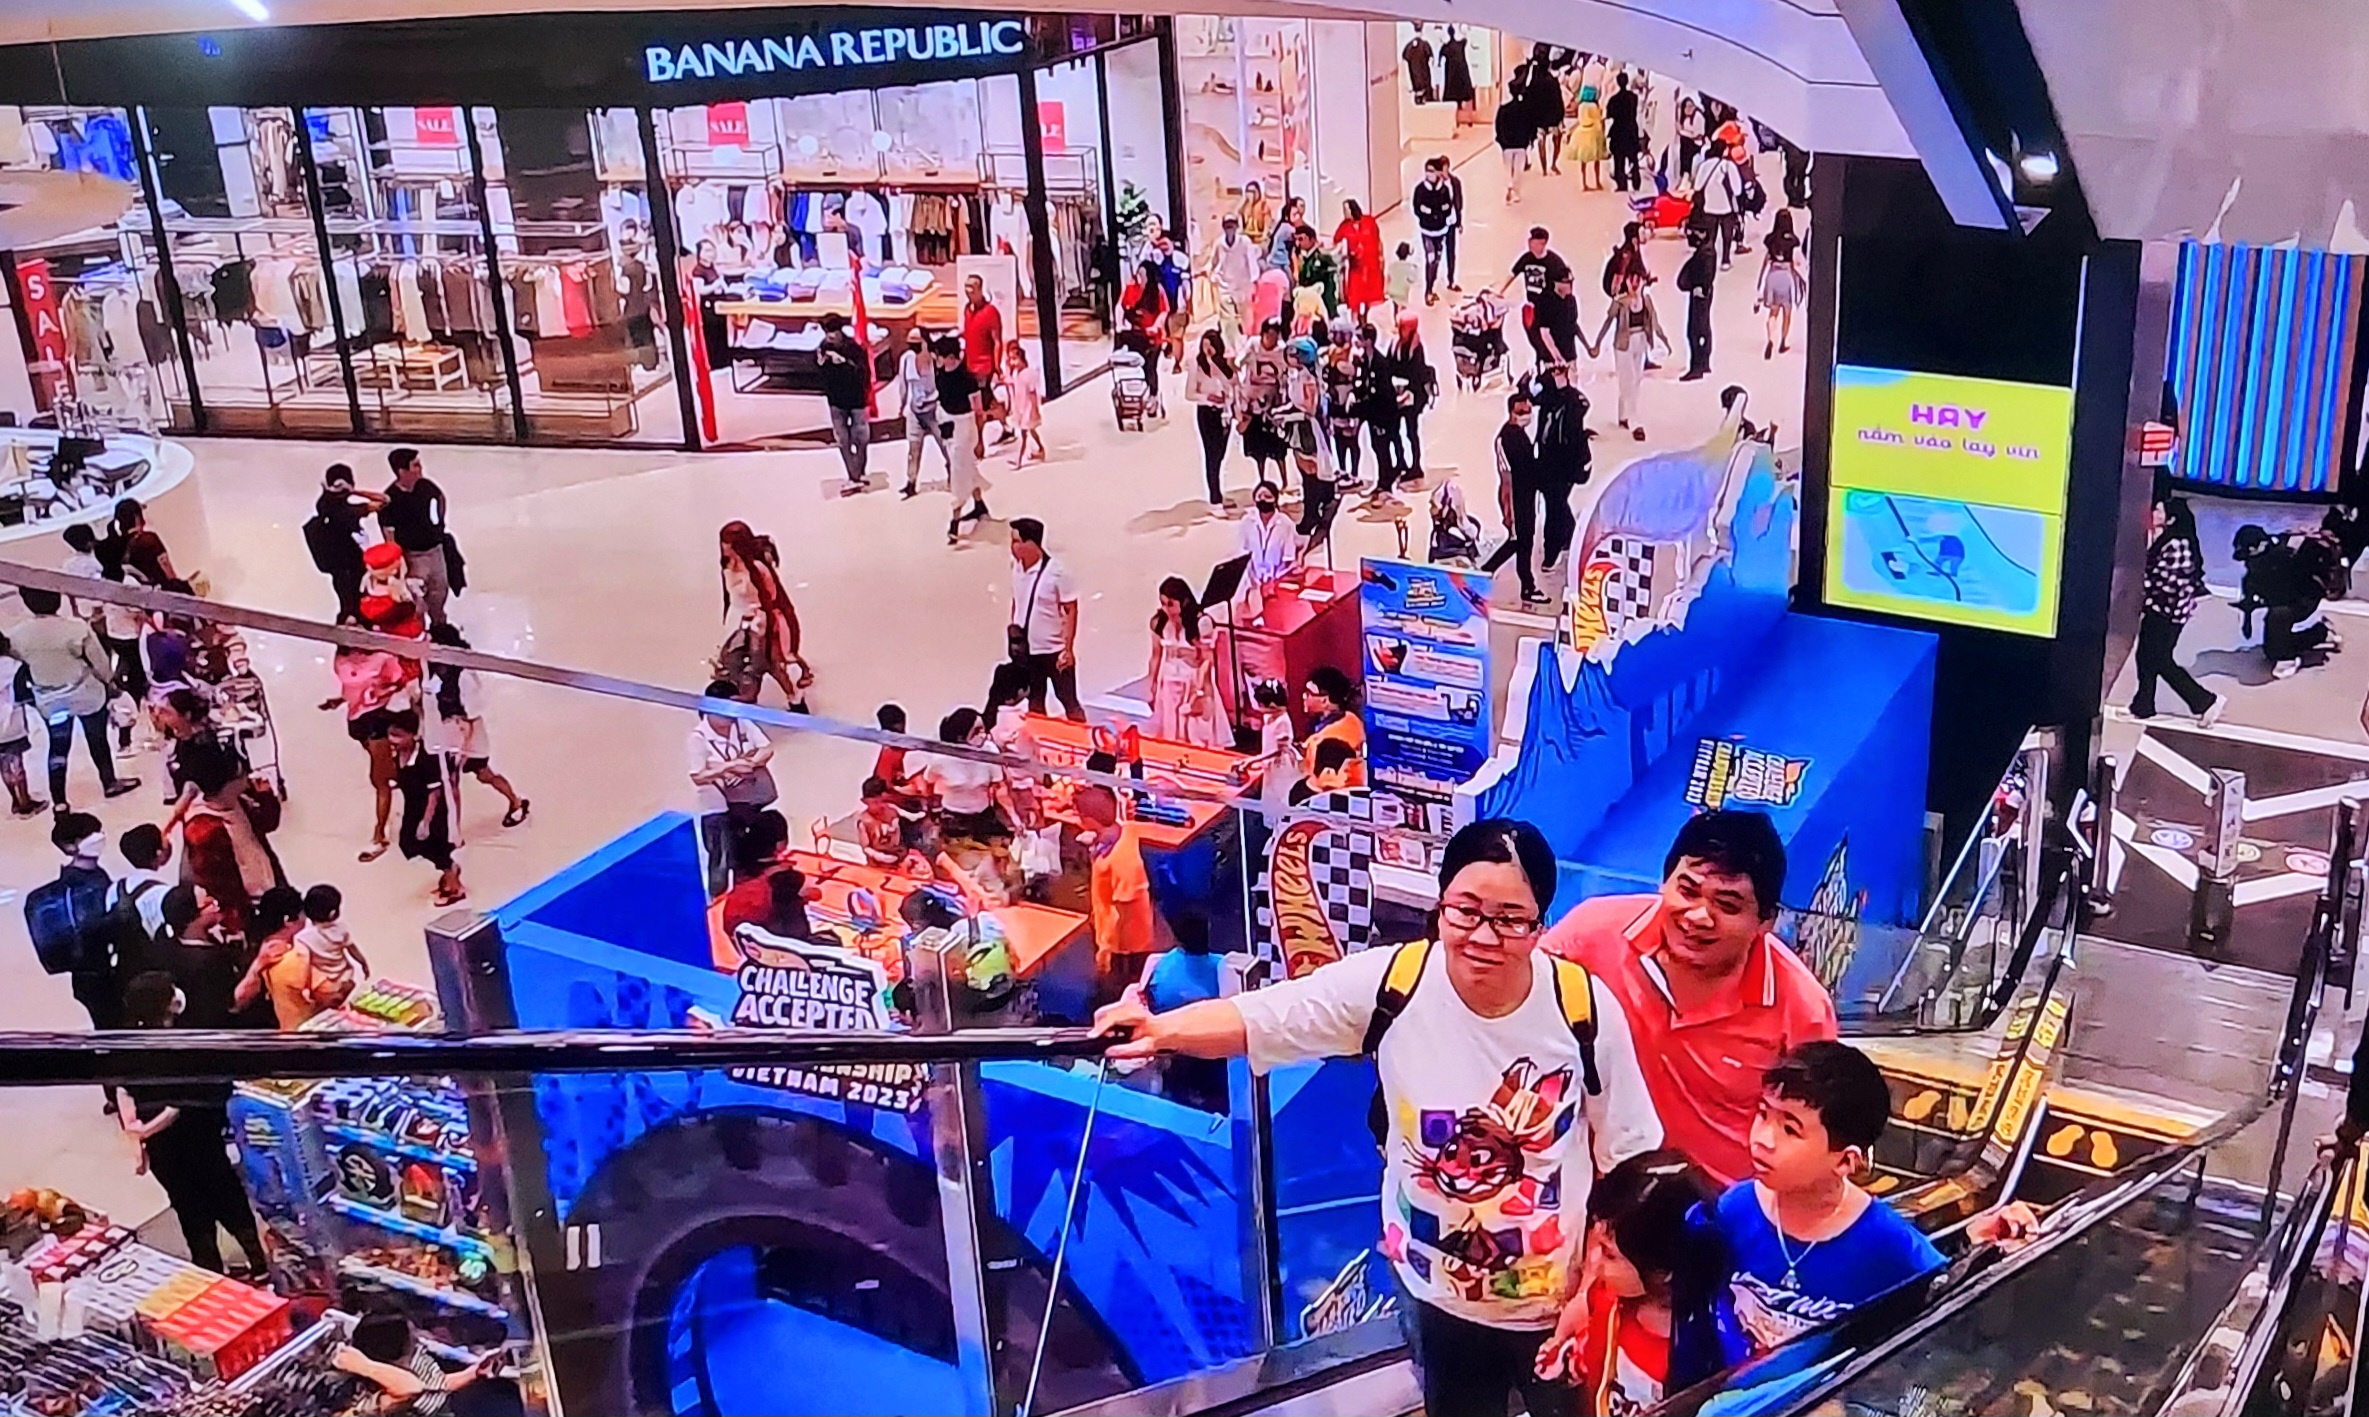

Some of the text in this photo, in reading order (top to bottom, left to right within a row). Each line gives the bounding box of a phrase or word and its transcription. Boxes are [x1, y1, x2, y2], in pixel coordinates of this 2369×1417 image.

[645, 20, 1024, 82] BANANA REPUBLIC
[709, 118, 747, 135] SALE
[740, 965, 872, 1008] CHALLENGE
[735, 994, 877, 1029] ACCEPTED
[846, 1081, 910, 1110] 2023
